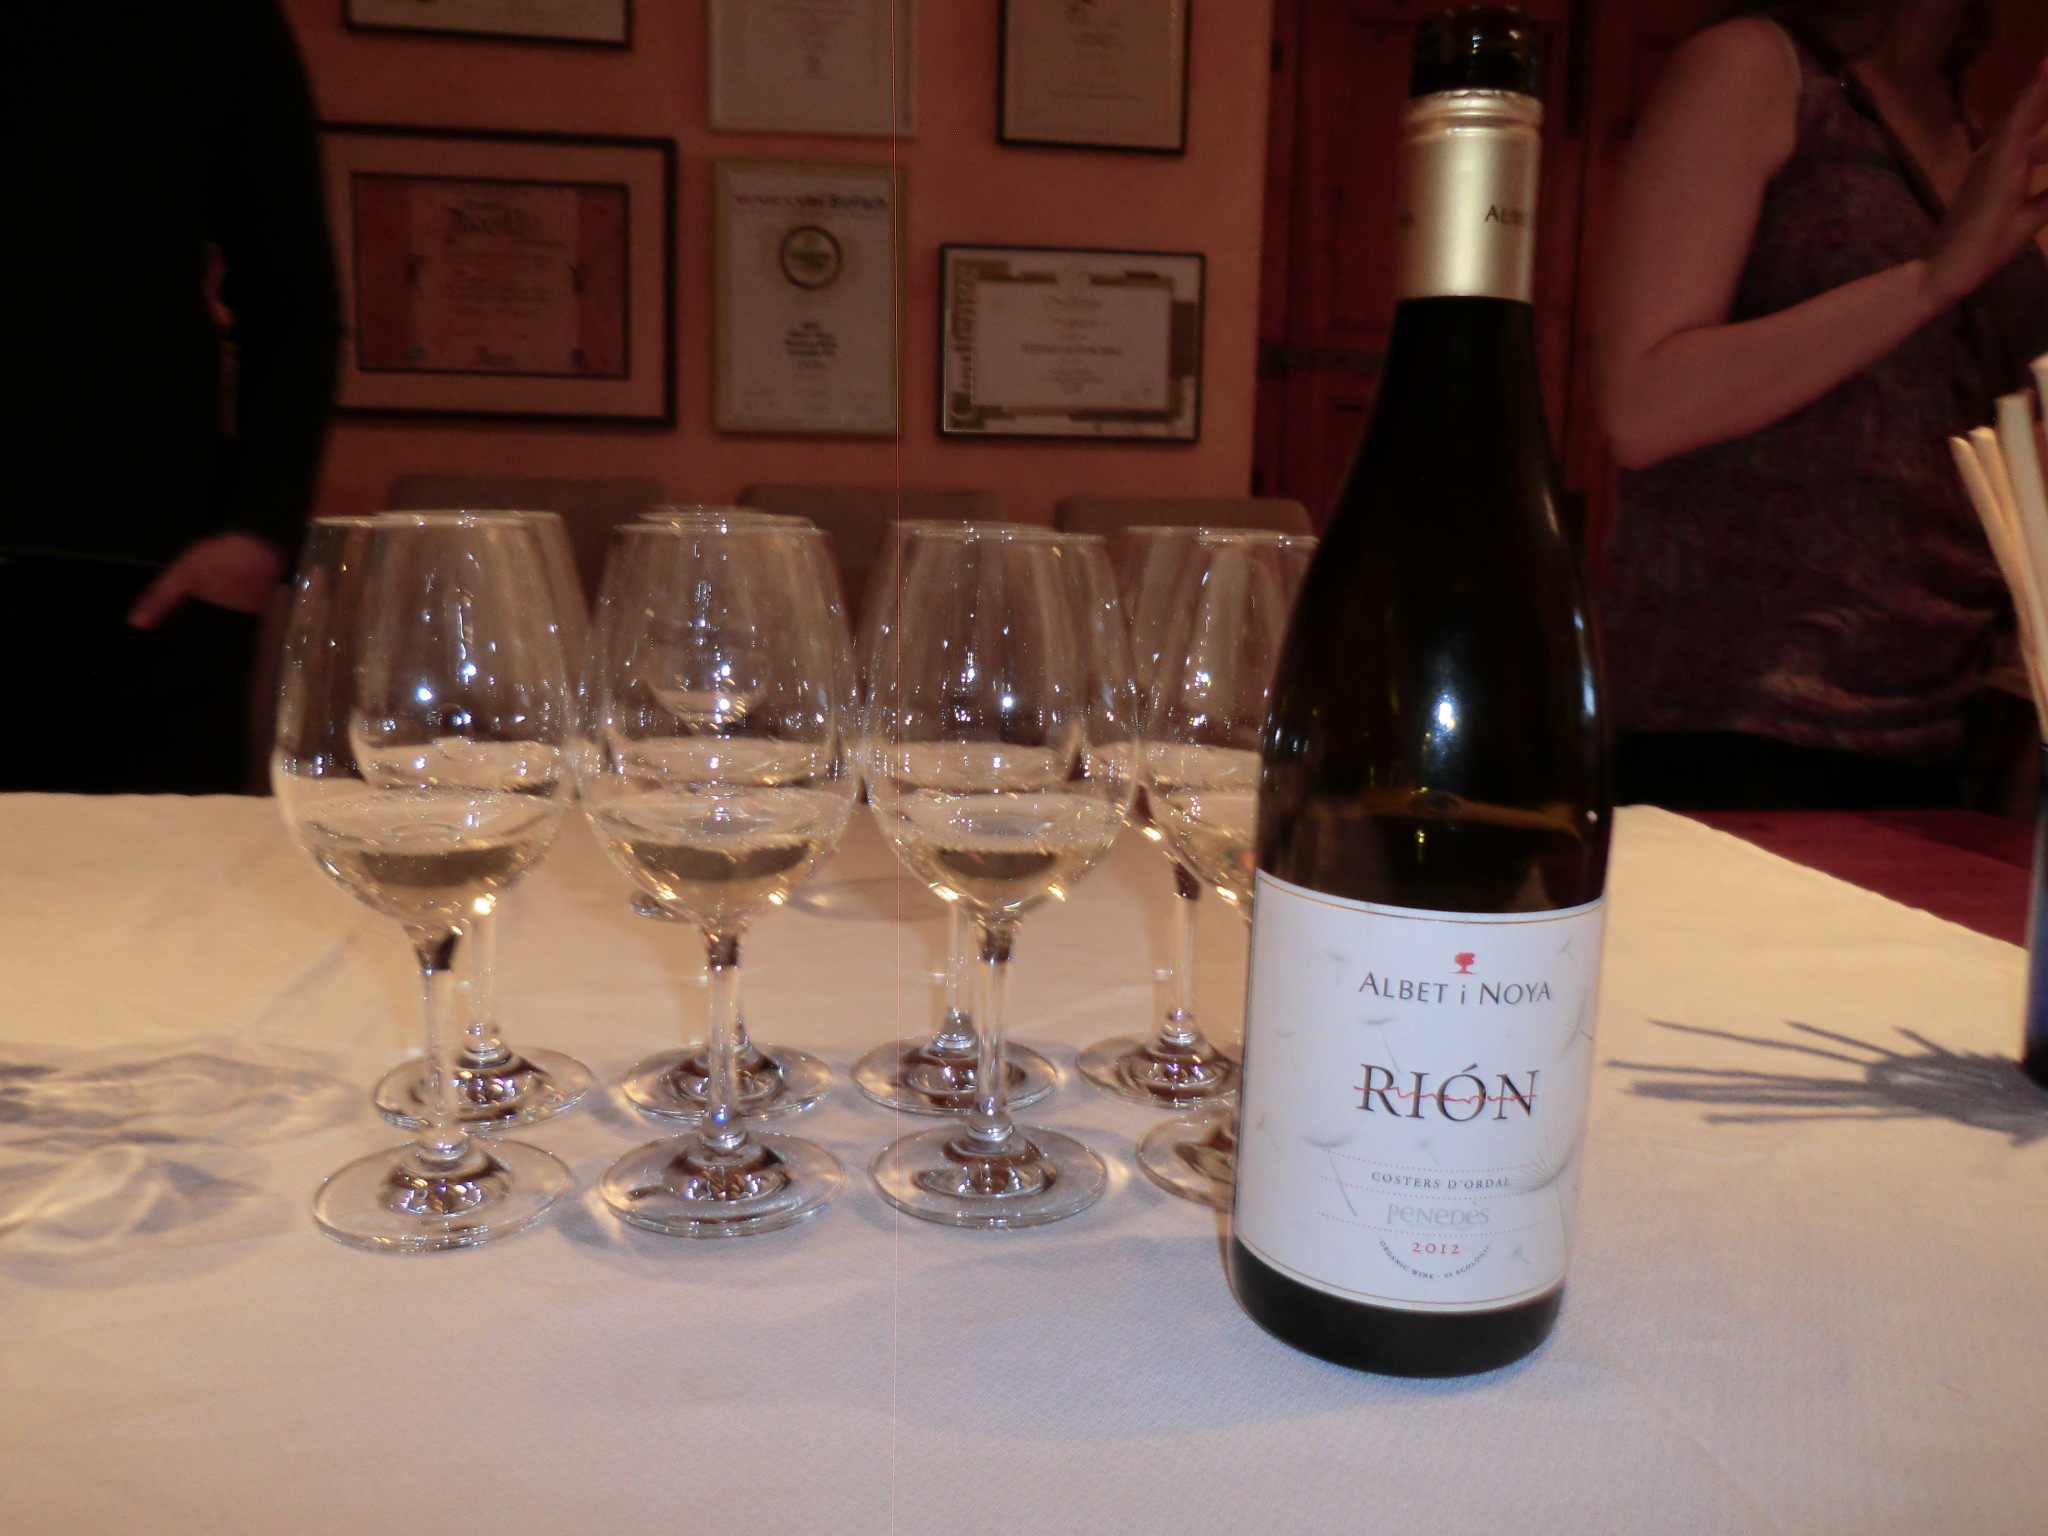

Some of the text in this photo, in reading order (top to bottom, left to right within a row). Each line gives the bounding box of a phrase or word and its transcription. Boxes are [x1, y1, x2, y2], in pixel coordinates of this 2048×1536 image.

[1358, 971, 1449, 1004] ALBET
[1479, 980, 1551, 1005] NOYA
[1356, 1062, 1540, 1122] RIÓN
[1371, 1170, 1511, 1190] COSTERS D'ORDAL
[1379, 1240, 1410, 1271] ORGANIC
[1411, 1268, 1435, 1279] WINE
[1412, 1241, 1460, 1255] 2012
